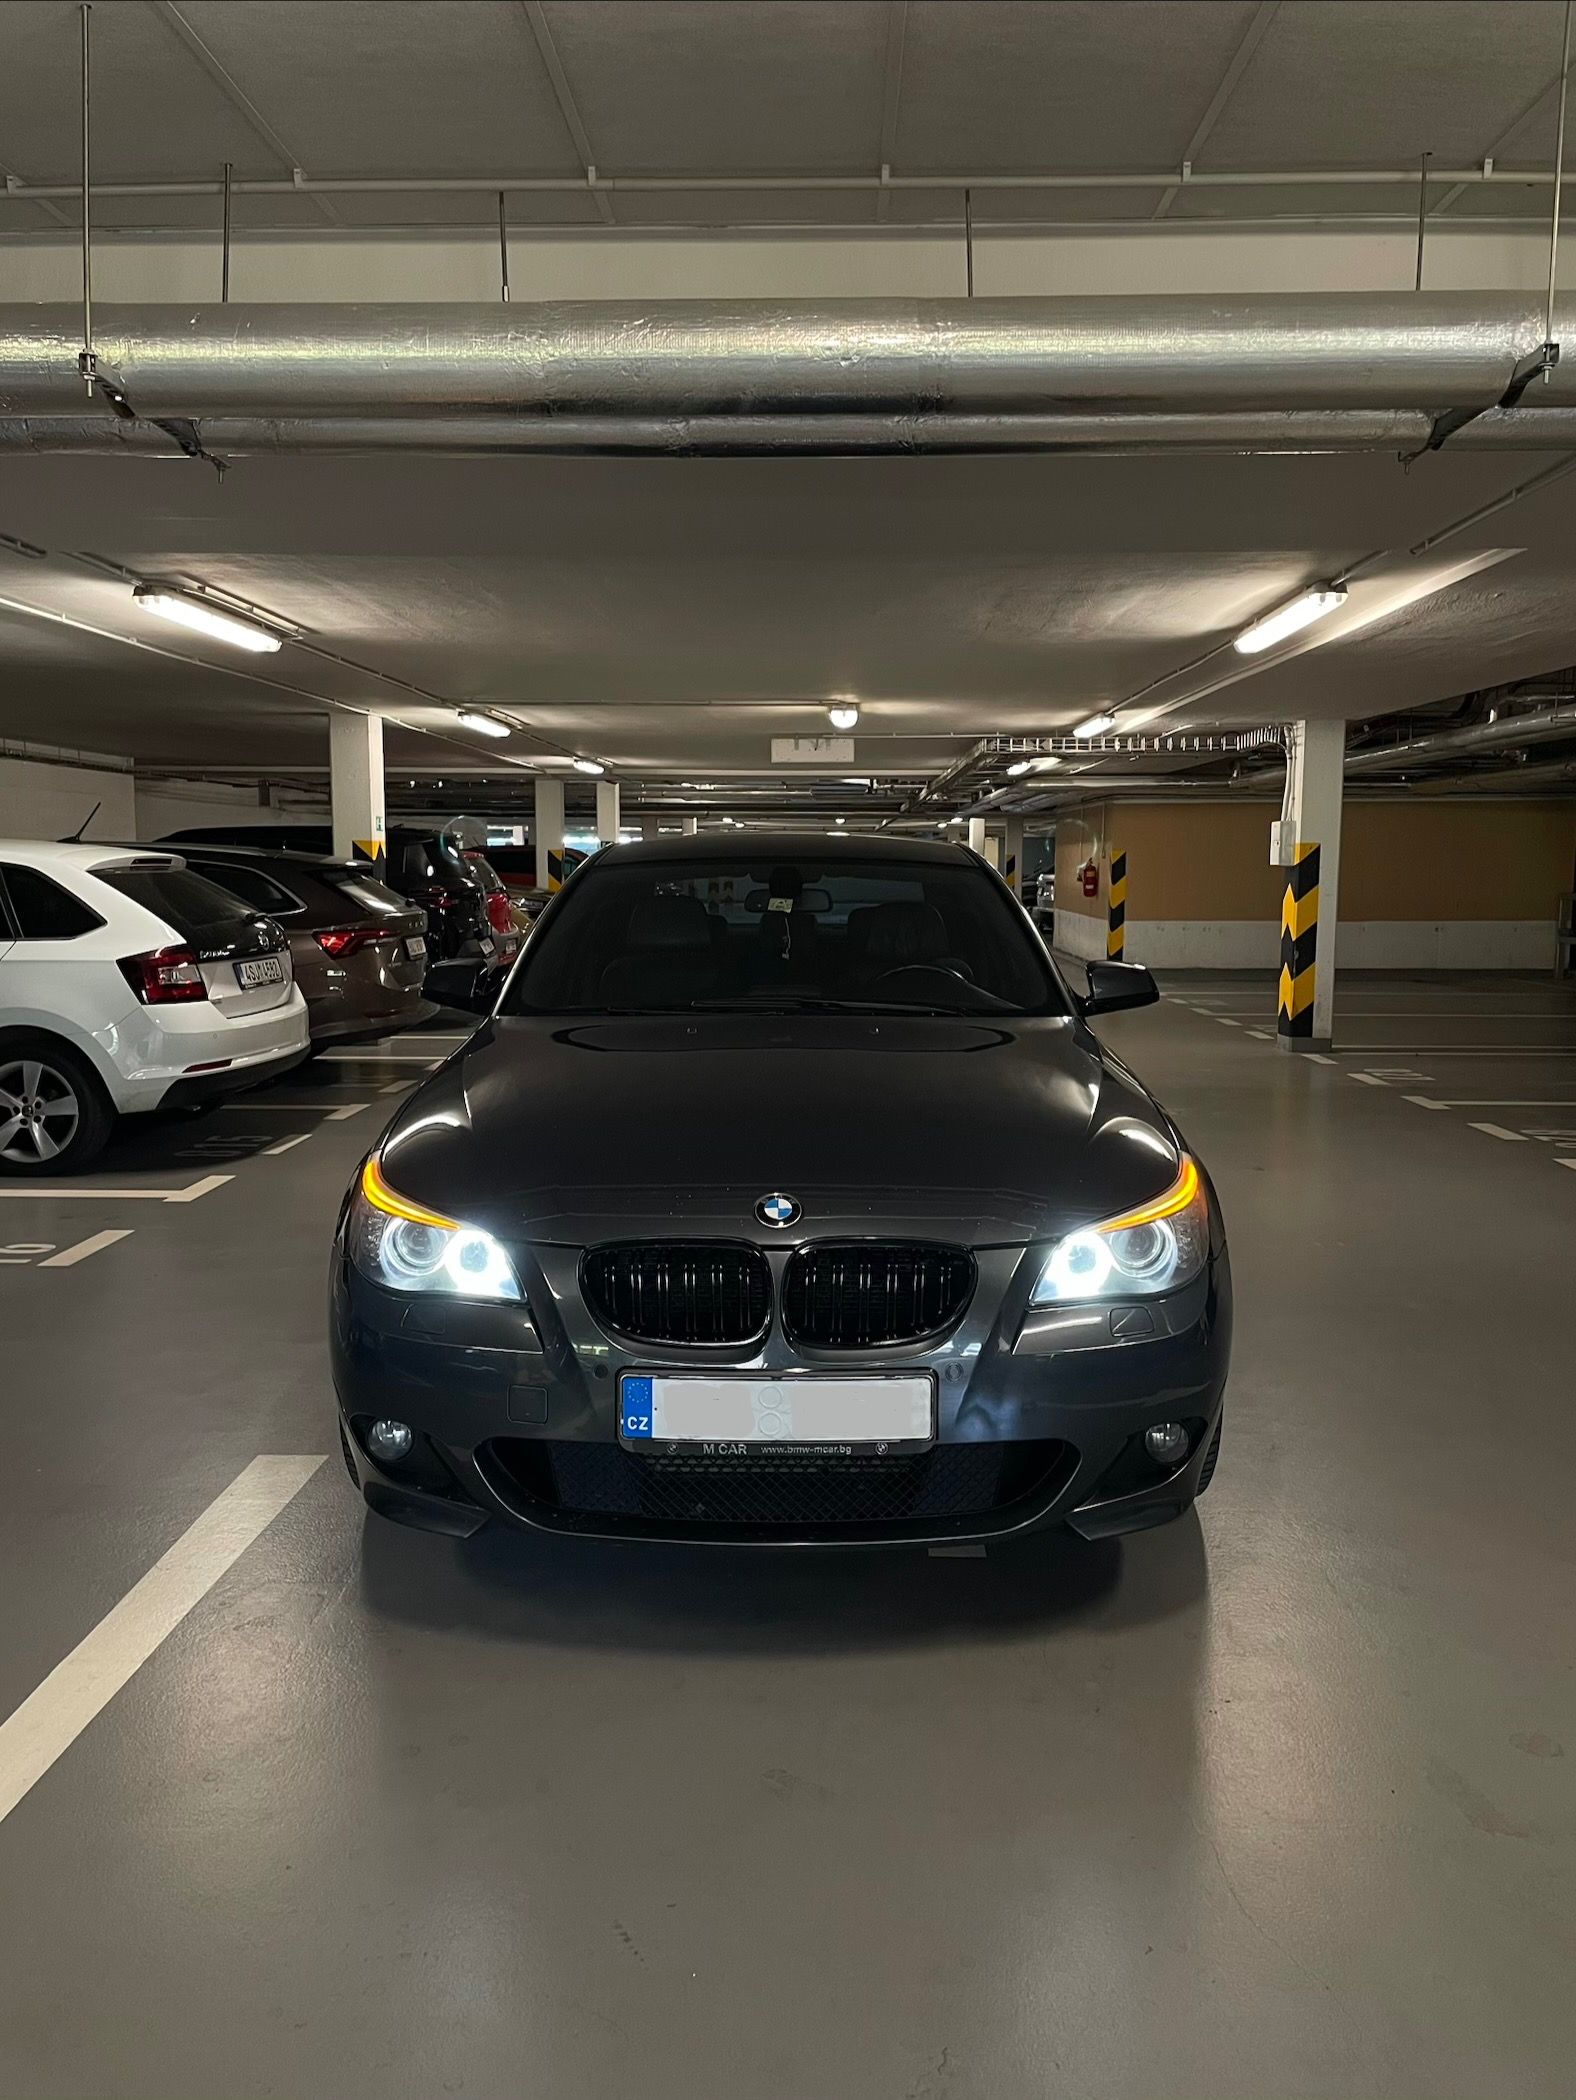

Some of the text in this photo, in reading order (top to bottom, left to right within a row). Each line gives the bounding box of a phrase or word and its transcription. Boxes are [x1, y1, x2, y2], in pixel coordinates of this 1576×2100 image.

[627, 1416, 649, 1431] CZ
[703, 1443, 748, 1455] M CAR
[760, 1444, 852, 1455] www.bmw-mcar.bg
